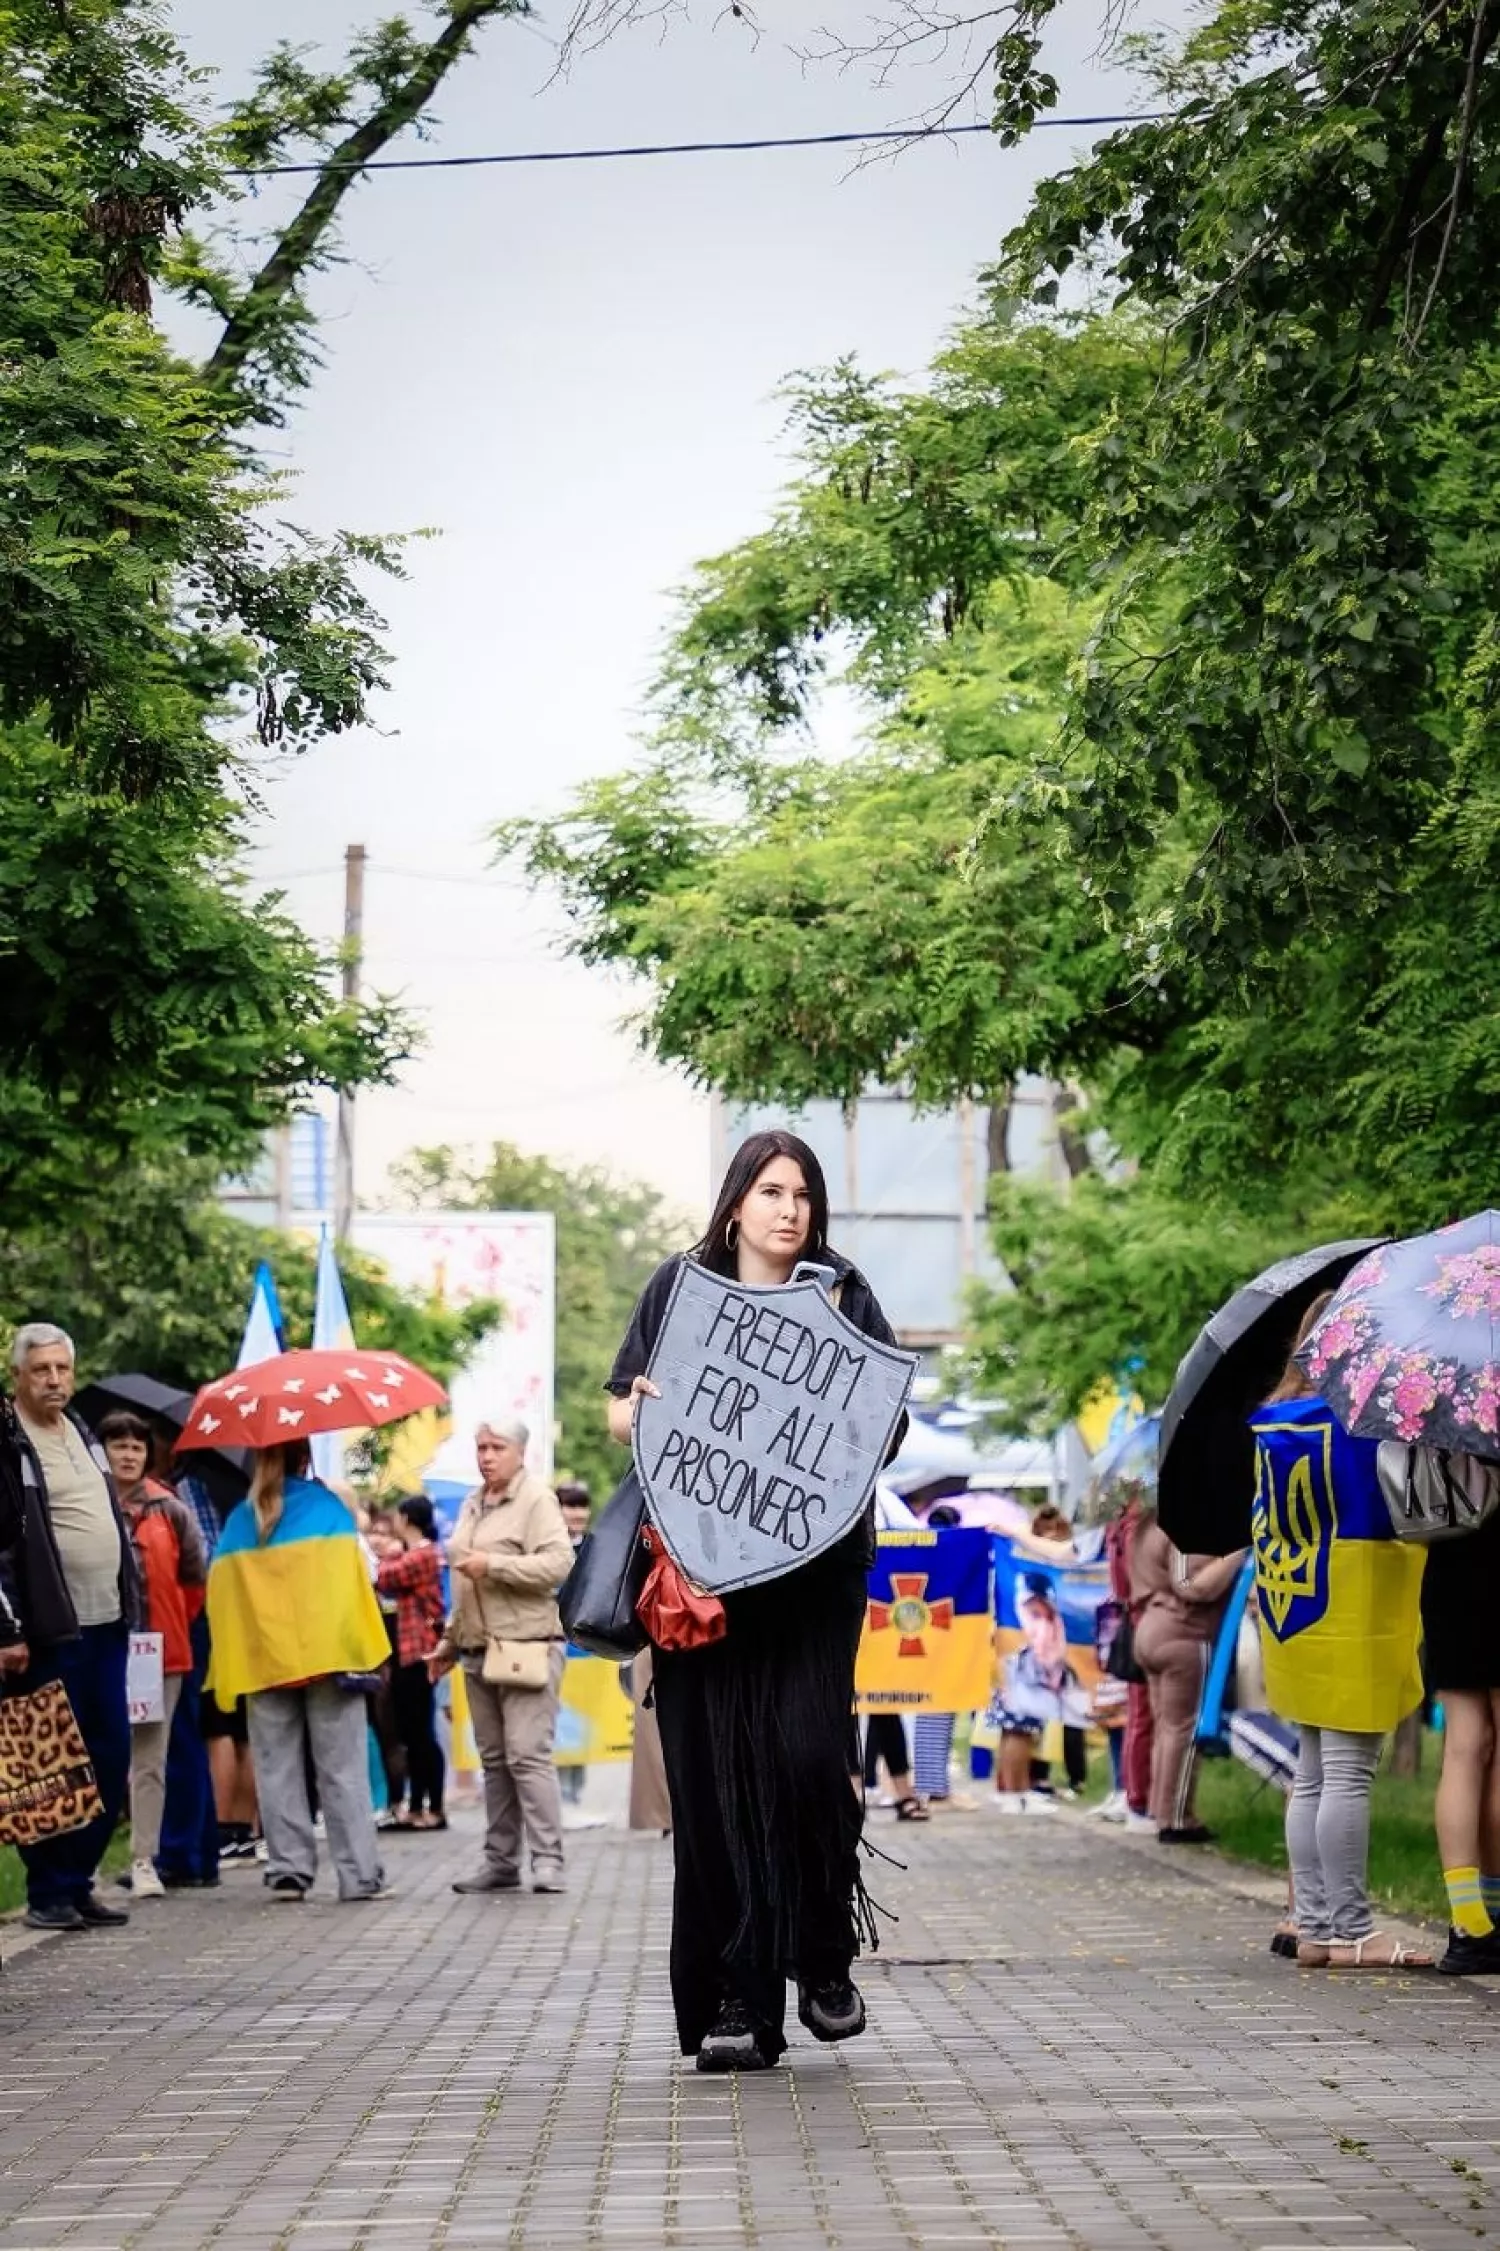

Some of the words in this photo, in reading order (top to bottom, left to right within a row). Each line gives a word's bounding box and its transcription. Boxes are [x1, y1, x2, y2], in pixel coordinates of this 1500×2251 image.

[705, 1292, 867, 1411] FREEDOM
[686, 1364, 760, 1442] FOR
[766, 1406, 834, 1481] ALL
[651, 1429, 826, 1551] PRISONERS
